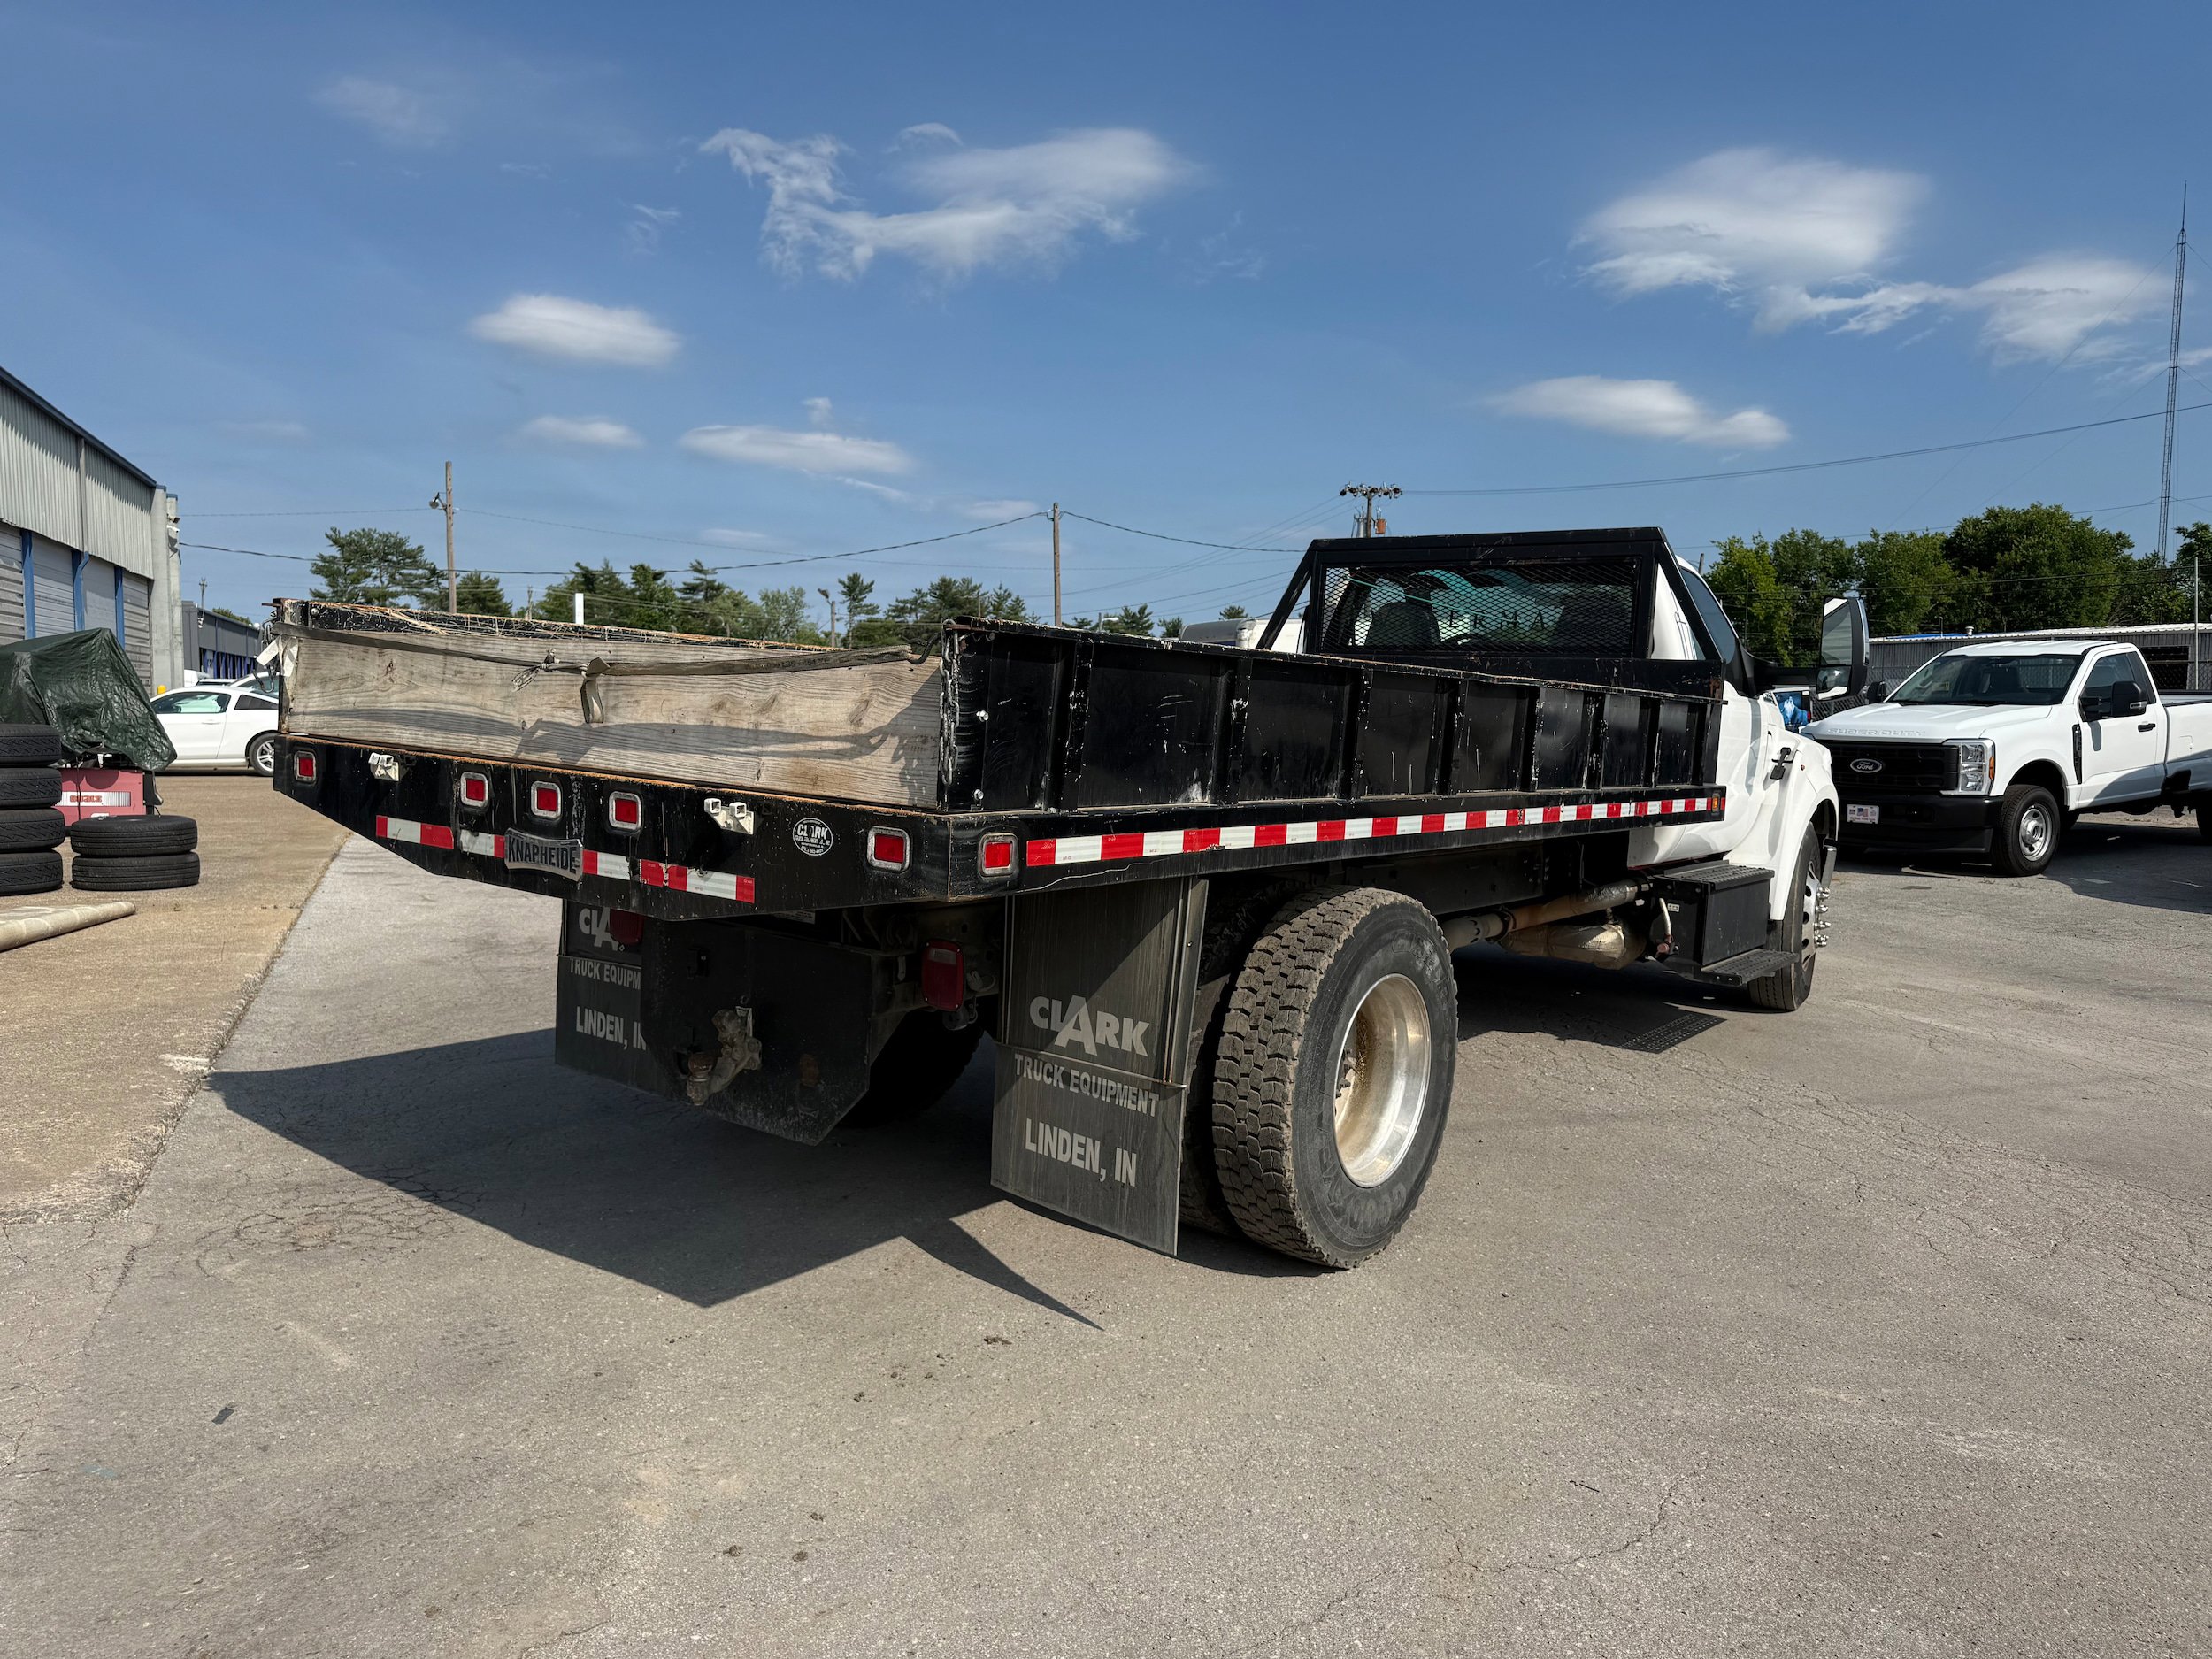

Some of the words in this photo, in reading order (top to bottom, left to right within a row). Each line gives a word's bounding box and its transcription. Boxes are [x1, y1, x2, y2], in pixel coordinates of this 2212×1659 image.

[1827, 727, 1878, 736] SUPER
[508, 834, 577, 875] KNAPHEIDE
[579, 907, 618, 951] CLA
[569, 957, 601, 981] TRUCK
[603, 964, 641, 990] EQUIPM
[576, 1005, 627, 1050] LINDEN,
[1029, 995, 1150, 1056] CLARK
[1015, 1053, 1065, 1089] TRUCK
[1069, 1070, 1160, 1118] EQUIPMENT
[1025, 1118, 1107, 1183] LINDEN,
[1114, 1147, 1138, 1187] IN
